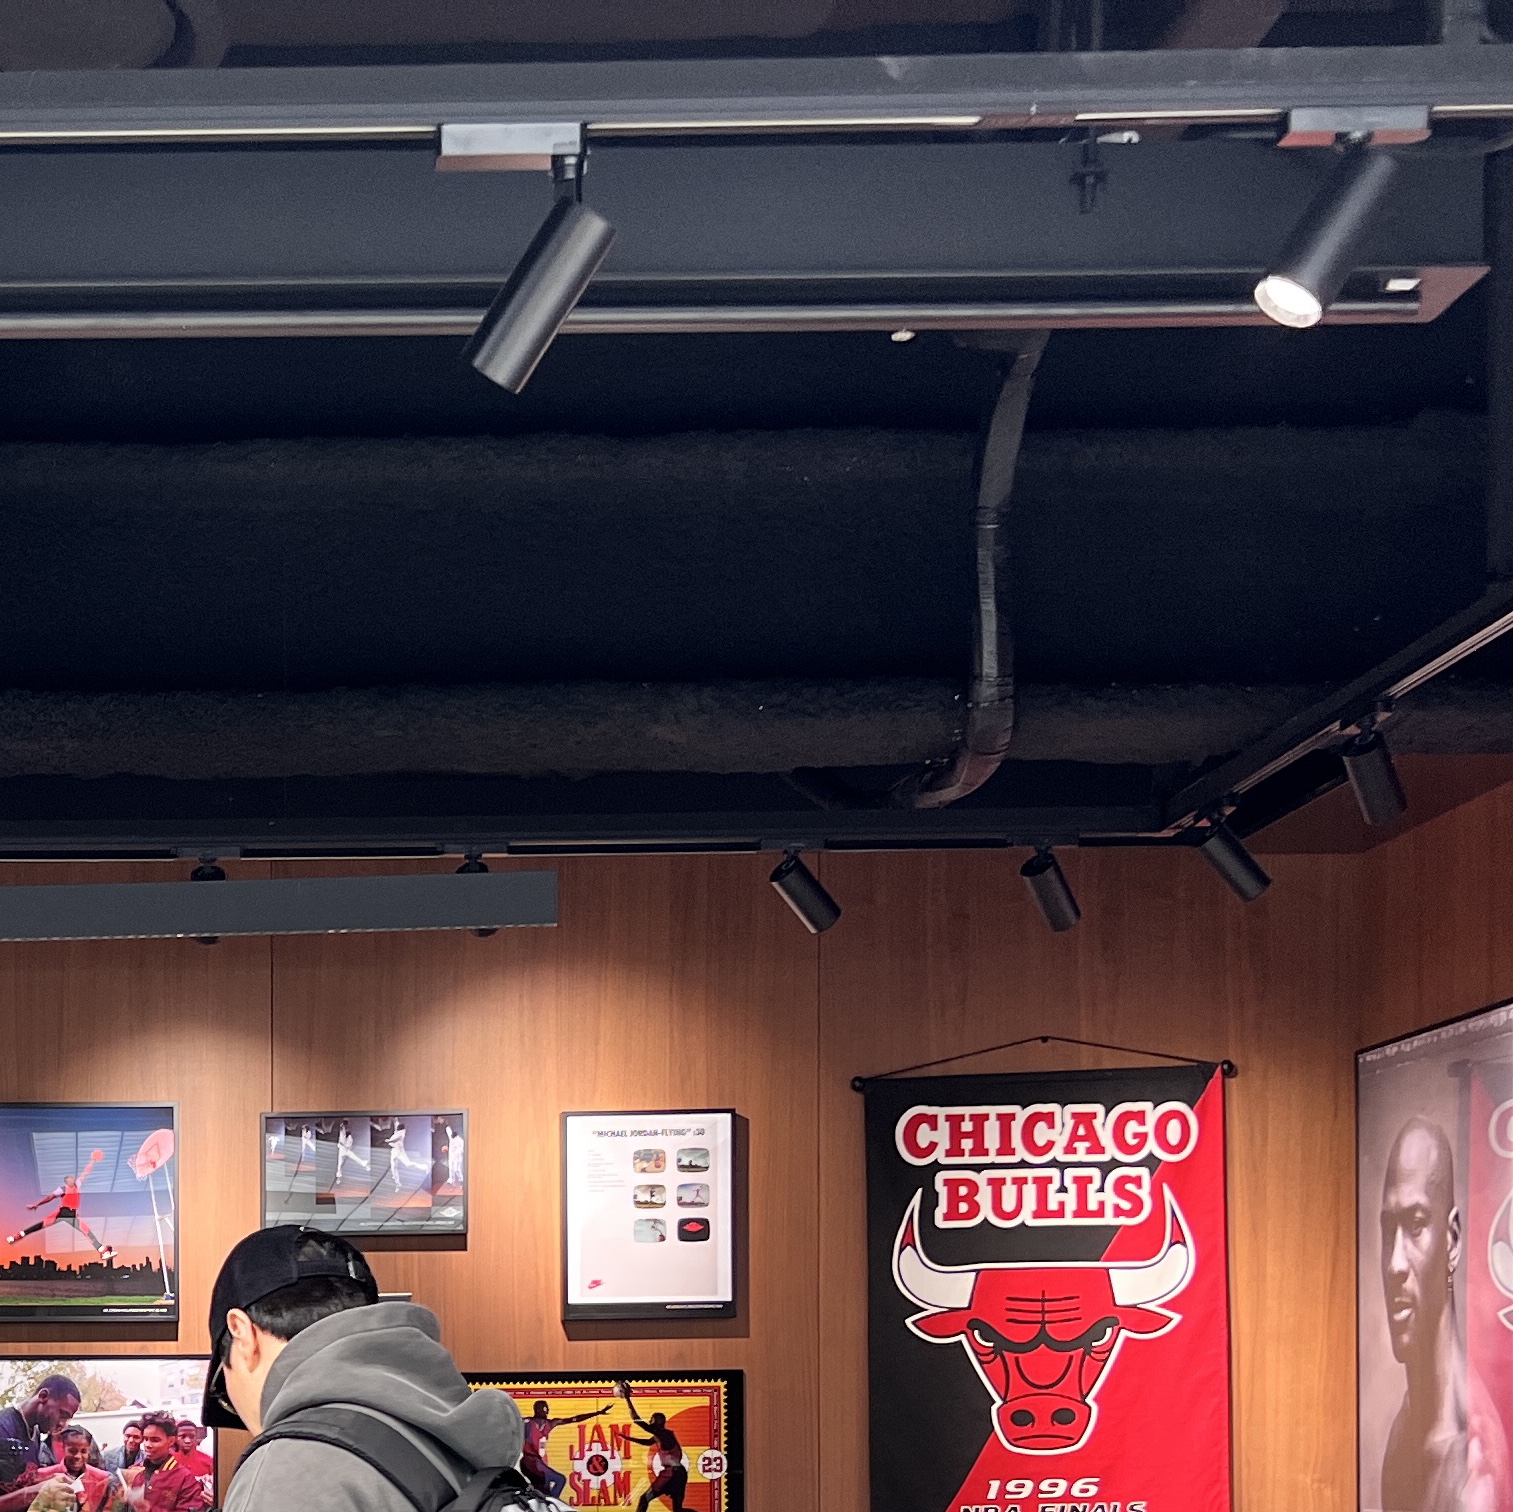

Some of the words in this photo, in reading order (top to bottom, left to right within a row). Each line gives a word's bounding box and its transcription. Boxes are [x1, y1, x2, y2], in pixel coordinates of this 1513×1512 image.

[895, 1101, 1199, 1166] CHICAGO
[934, 1166, 1151, 1228] BULLS
[569, 1423, 632, 1461] JAM
[588, 1454, 606, 1475] &
[701, 1456, 724, 1474] 23
[569, 1470, 632, 1507] SLAM
[986, 1477, 1101, 1500] 1996
